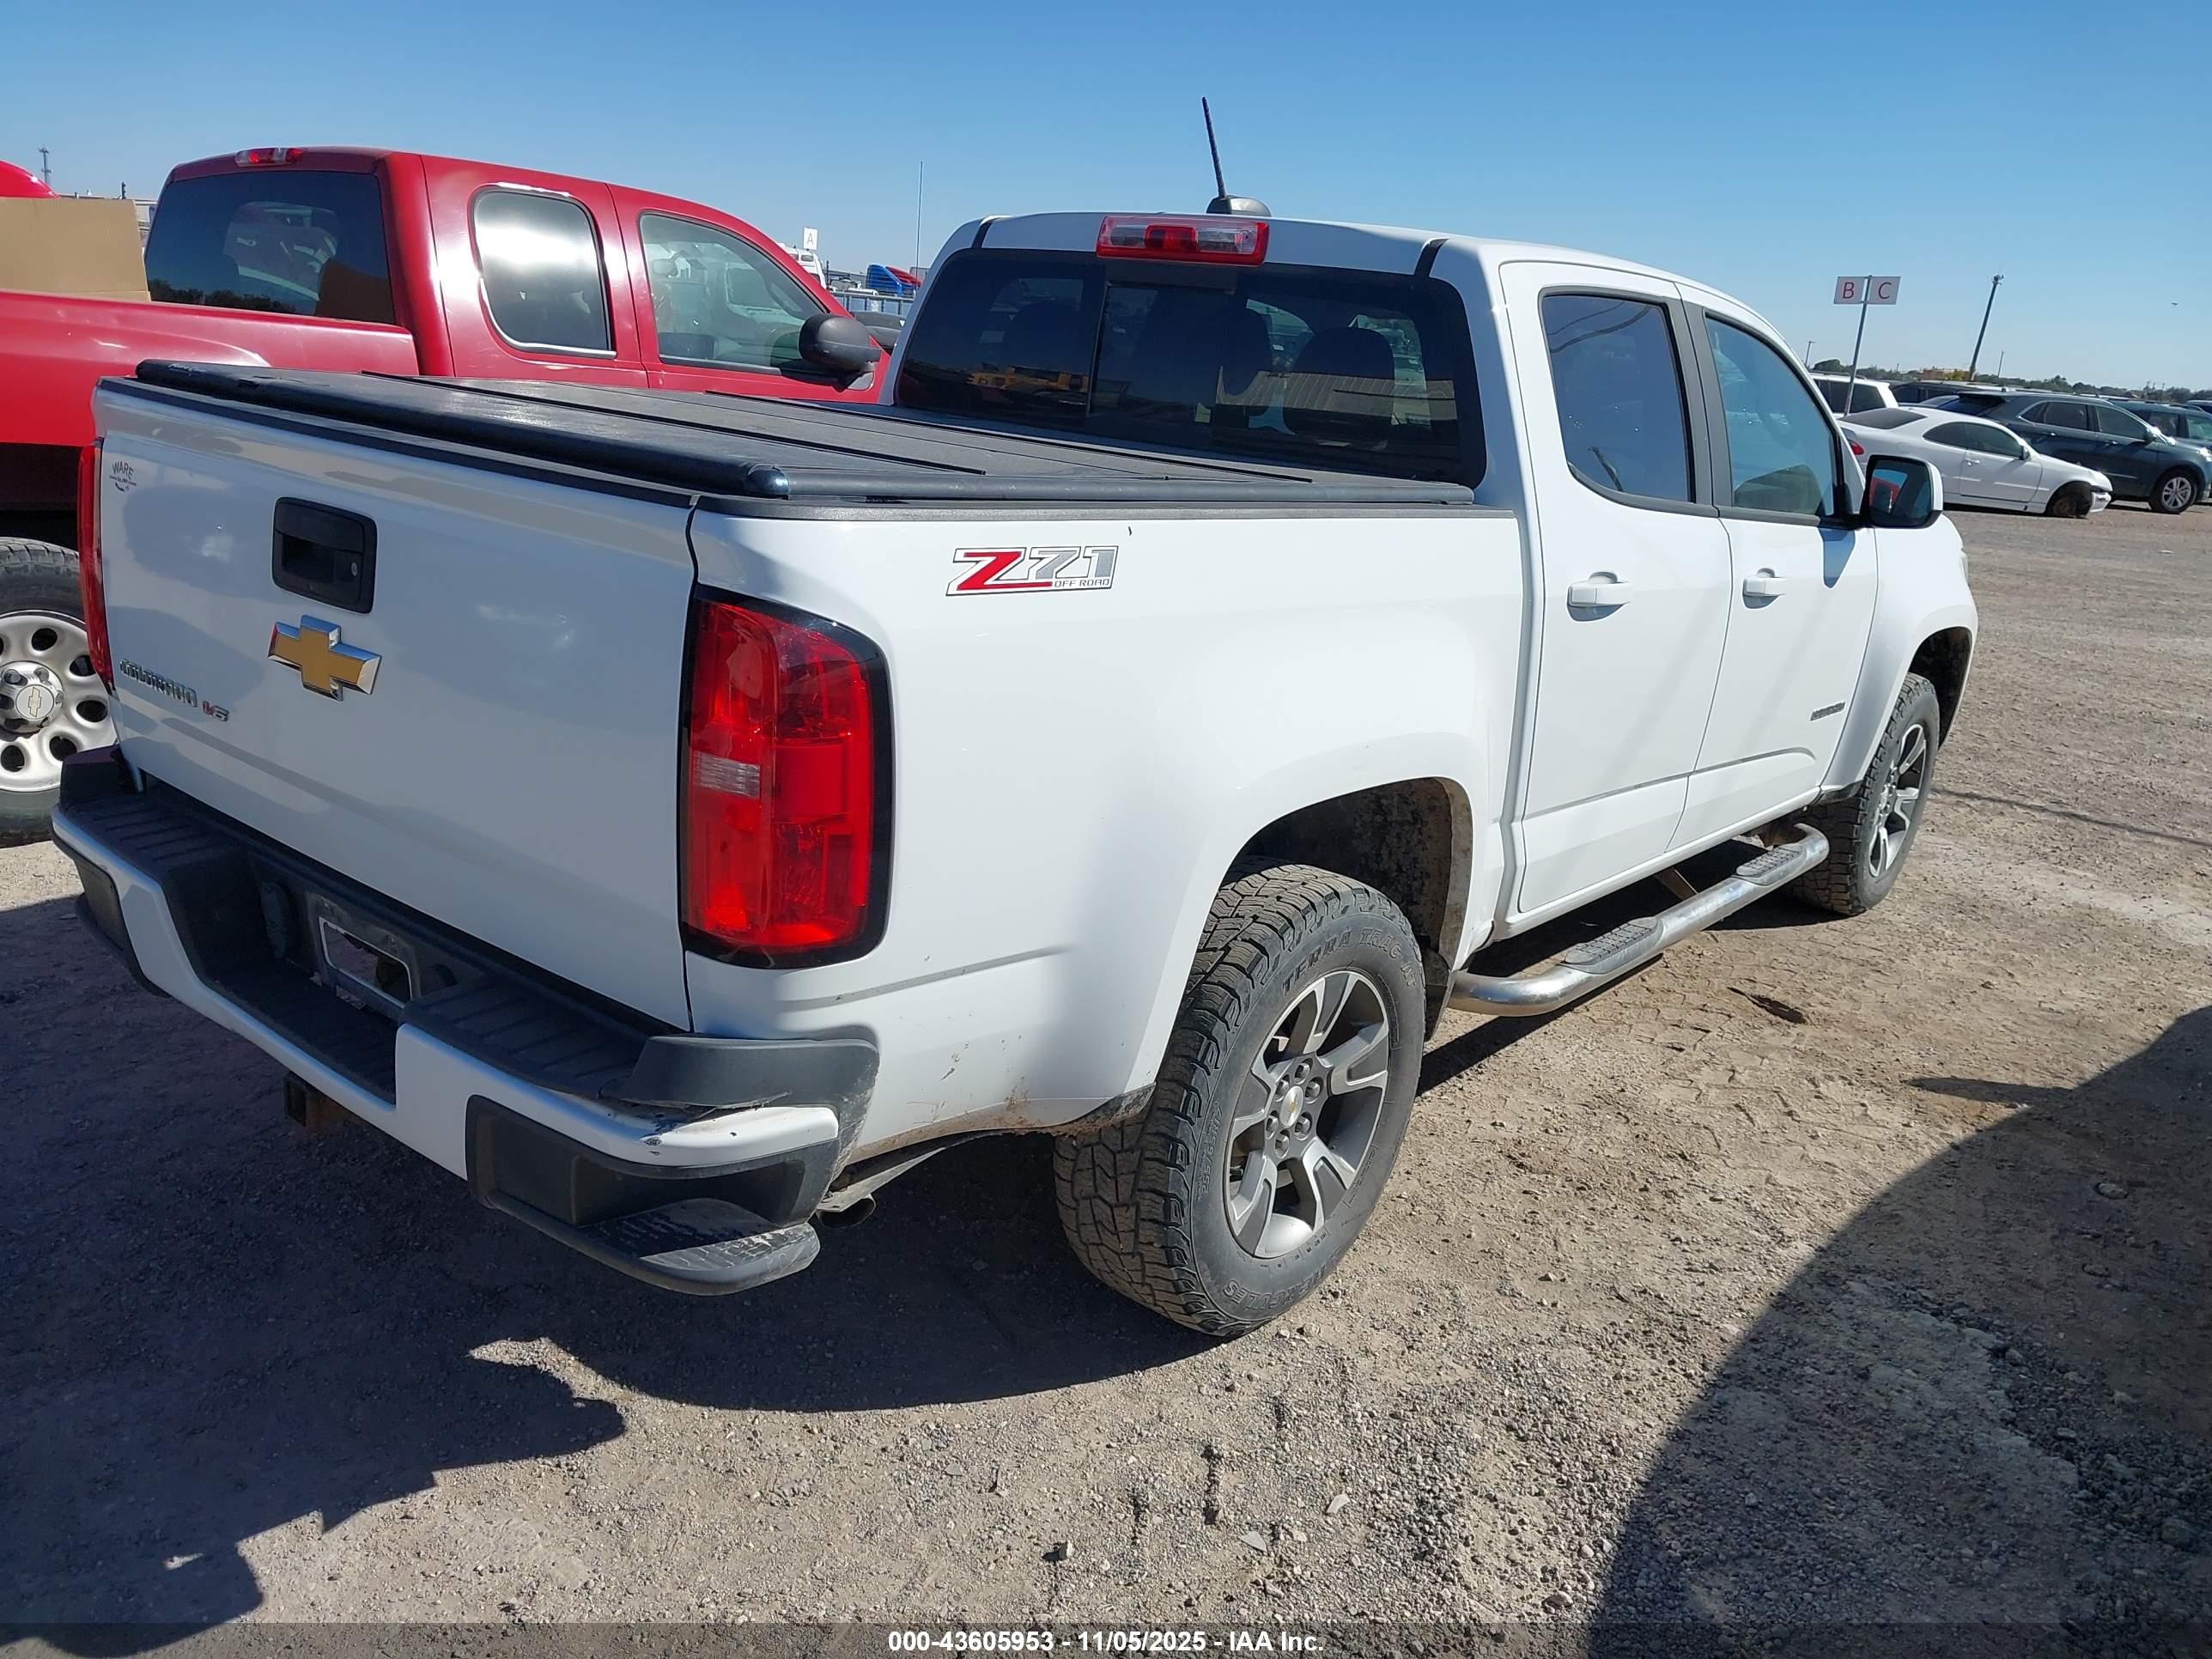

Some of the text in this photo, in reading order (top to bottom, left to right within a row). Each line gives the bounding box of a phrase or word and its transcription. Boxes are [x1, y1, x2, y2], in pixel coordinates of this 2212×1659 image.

[807, 232, 814, 245] A
[1842, 282, 1855, 299] B
[1878, 282, 1892, 299] C
[112, 460, 134, 480] WARE
[950, 547, 1117, 593] Z71
[202, 700, 230, 721] V6
[1282, 927, 1353, 996] TERRA
[1359, 927, 1403, 959] TRAC
